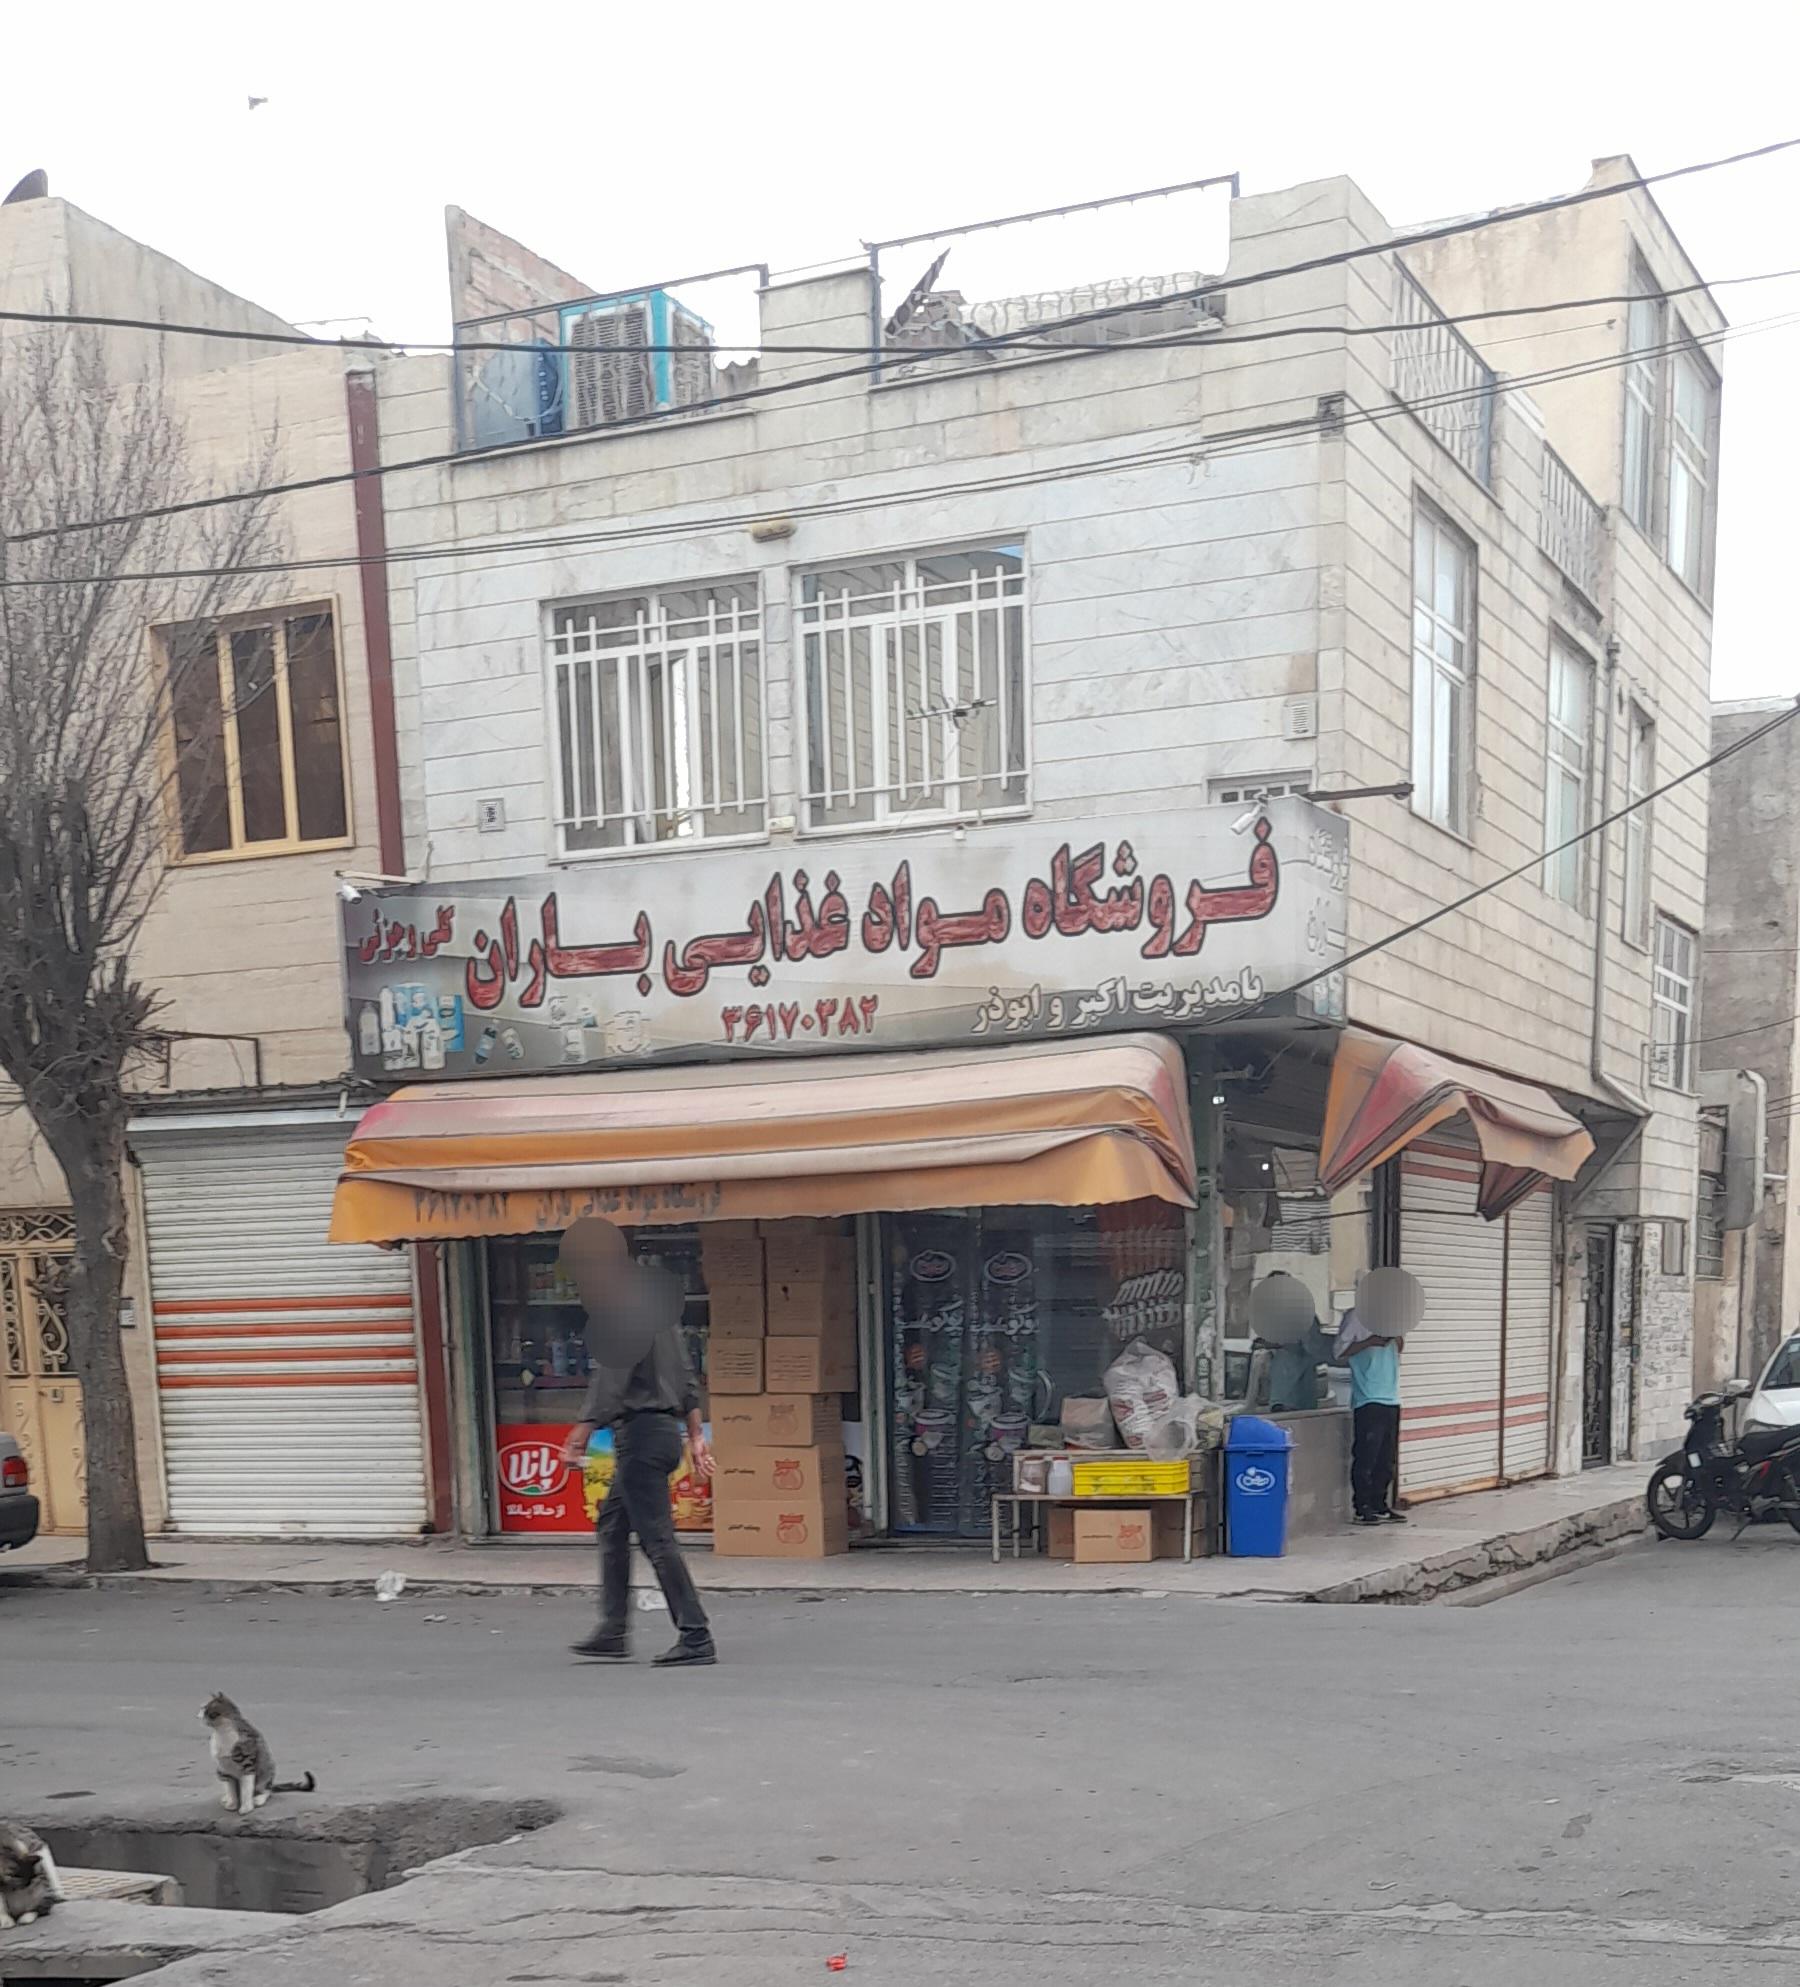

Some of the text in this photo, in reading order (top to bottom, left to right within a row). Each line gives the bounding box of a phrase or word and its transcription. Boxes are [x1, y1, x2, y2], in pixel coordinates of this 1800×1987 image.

[466, 816, 1281, 1009] فروشگاه مواد غذایی باران
[721, 994, 878, 1043] ۳۶۱۷۰۳۸۲
[971, 984, 1042, 1034] ابوذر
[1046, 995, 1064, 1028] و
[1071, 976, 1126, 1029] اکبر
